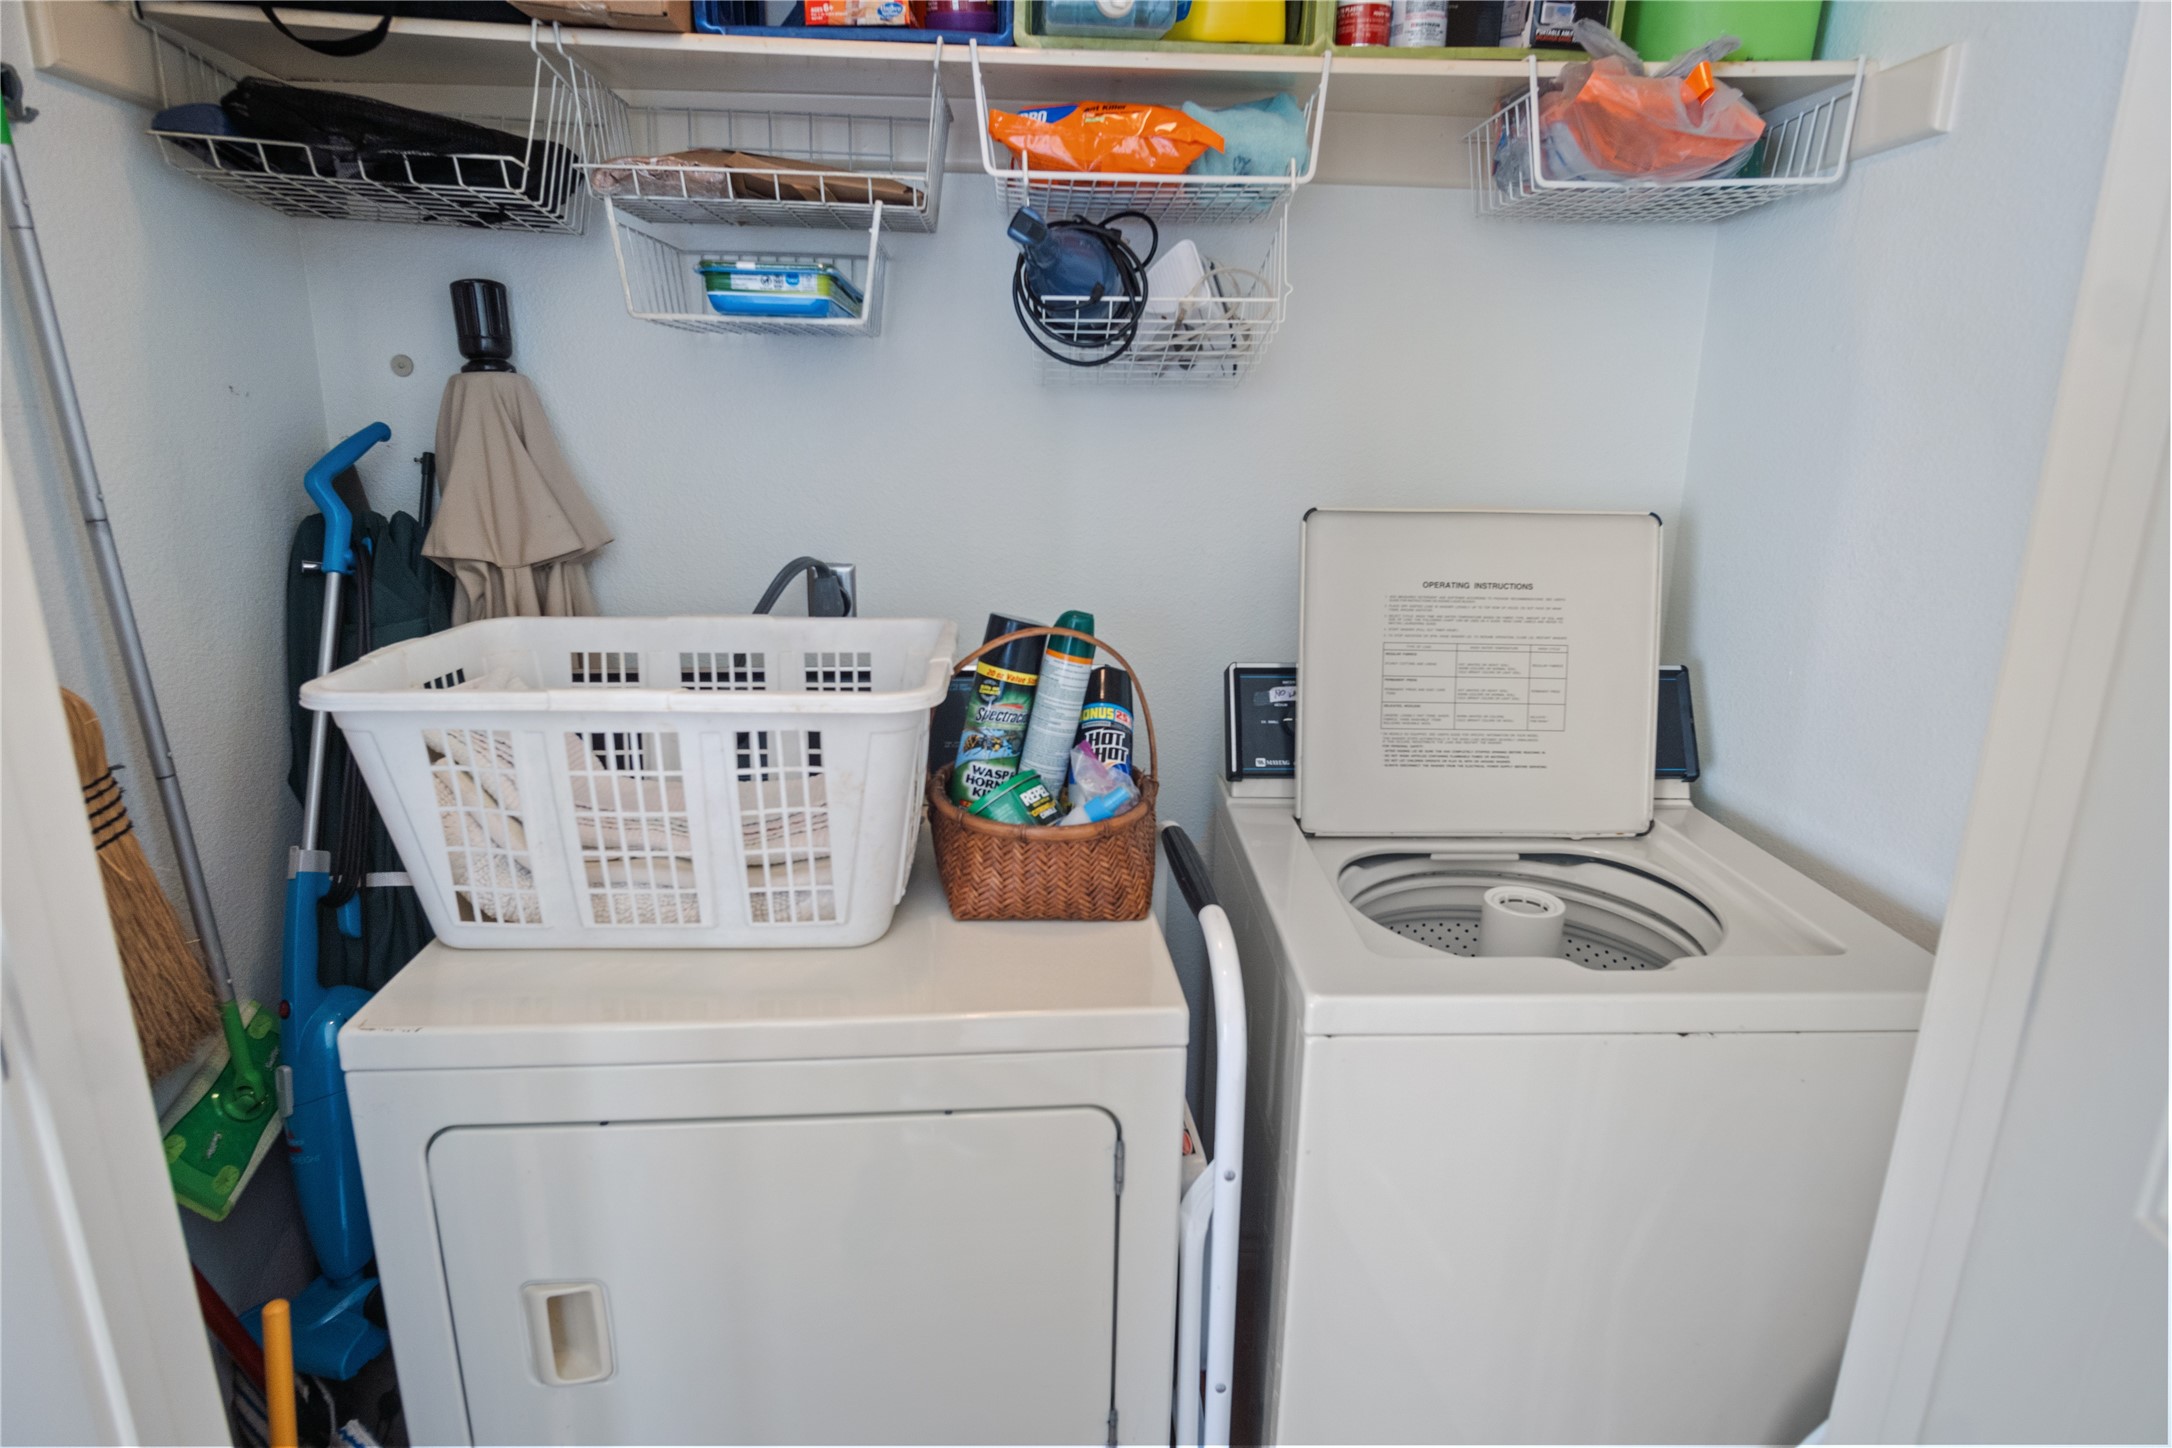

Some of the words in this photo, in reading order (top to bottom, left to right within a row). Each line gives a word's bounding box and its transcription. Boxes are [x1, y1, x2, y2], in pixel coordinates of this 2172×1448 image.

[1422, 581, 1470, 589] OPERATING
[1474, 582, 1534, 590] INSTRUCTIONS
[1006, 673, 1026, 684] Value
[1085, 728, 1126, 748] HOT
[1092, 747, 1129, 764] HOT
[972, 764, 1009, 780] WASP
[965, 774, 1003, 790] HORN
